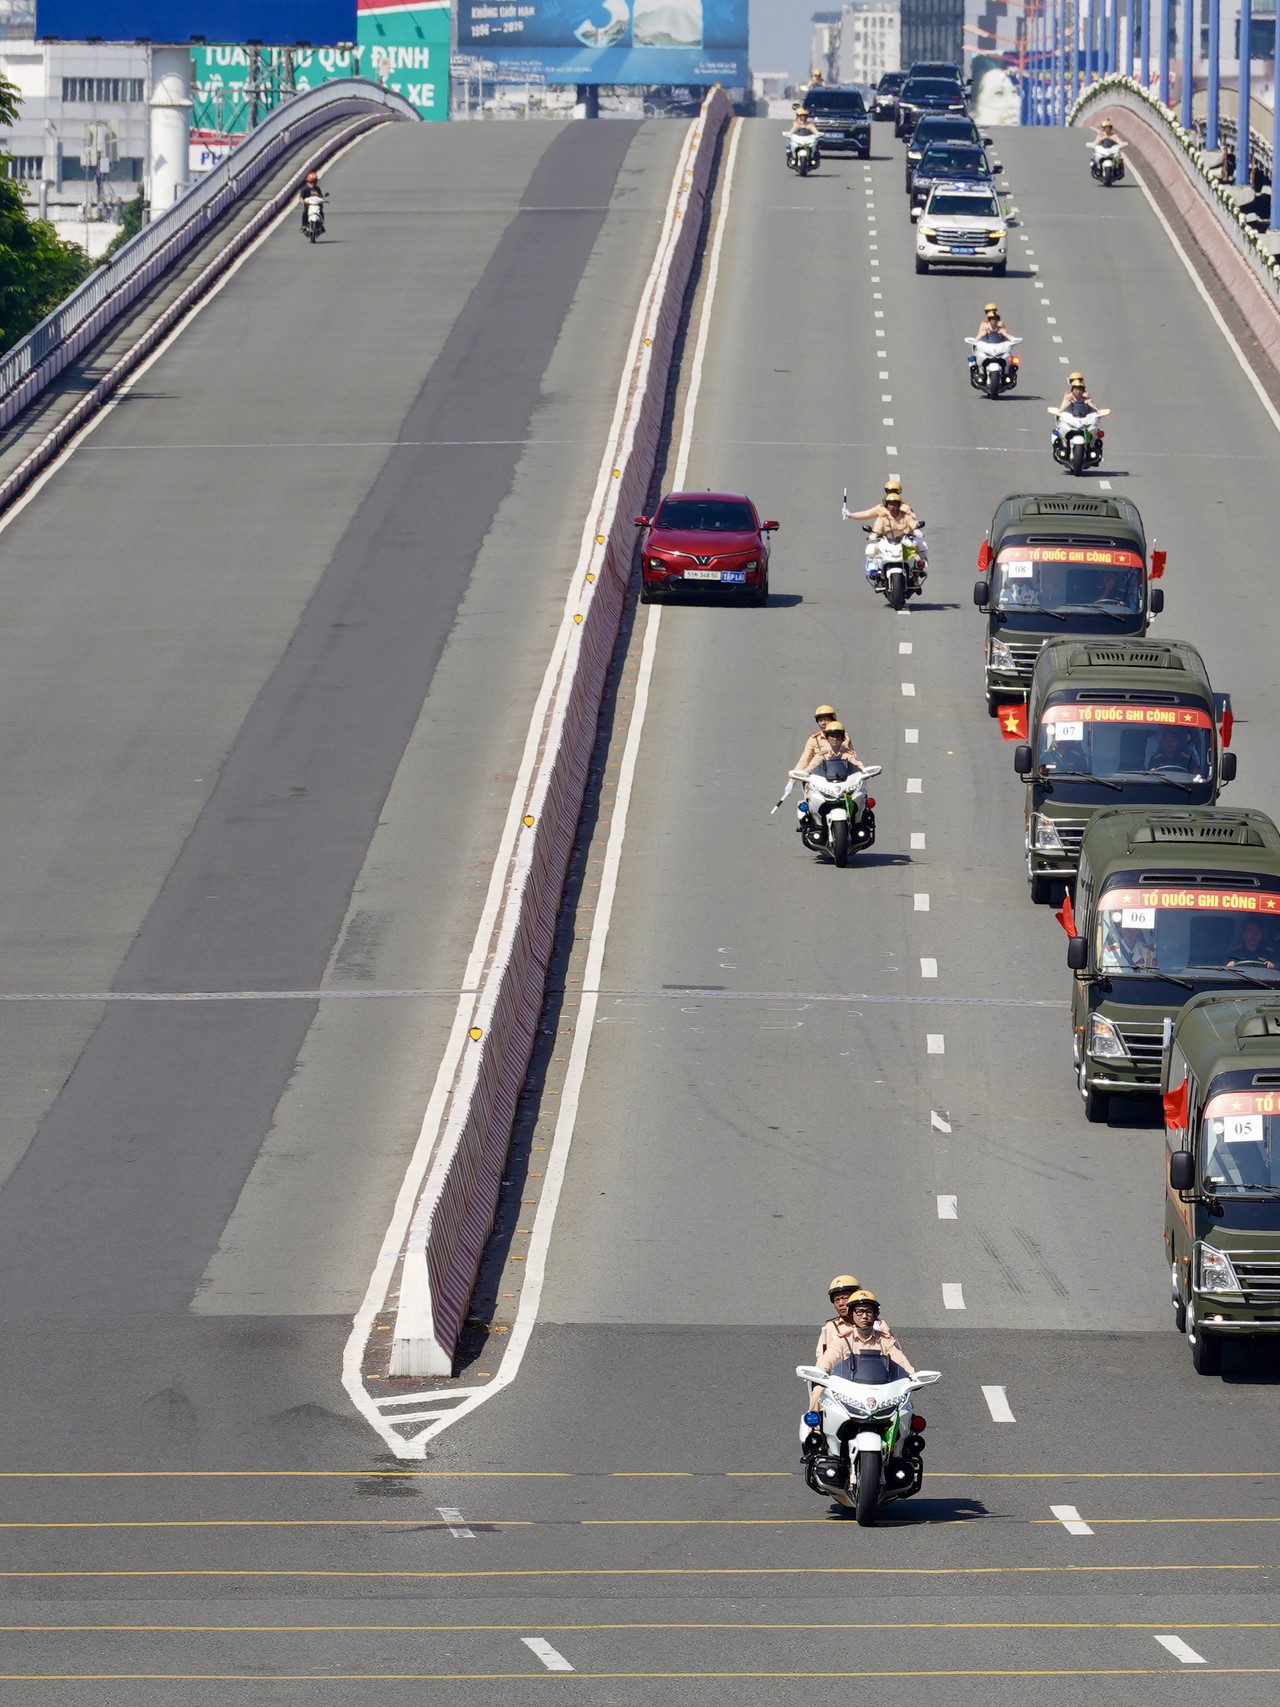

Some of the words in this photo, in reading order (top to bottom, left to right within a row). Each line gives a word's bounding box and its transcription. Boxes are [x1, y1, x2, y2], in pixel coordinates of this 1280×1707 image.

[407, 84, 435, 106] XE
[1029, 550, 1040, 560] TỔ
[1042, 549, 1067, 561] QUỐC
[1069, 551, 1084, 561] GHI
[1087, 551, 1112, 563] CÔNG
[1014, 565, 1026, 573] 08
[1079, 706, 1092, 719] TỔ
[1095, 706, 1123, 721] QUỐC
[1126, 710, 1144, 721] GHI
[1147, 708, 1176, 722] CÔNG
[1062, 727, 1075, 736] 07
[1143, 889, 1158, 906] TỔ
[1161, 890, 1194, 908] QUỐC
[1198, 895, 1218, 907] GHI
[1222, 893, 1256, 909] CÔNG
[1131, 912, 1146, 923] 06
[1256, 1091, 1273, 1112] TỔ
[1234, 1122, 1252, 1135] 05
